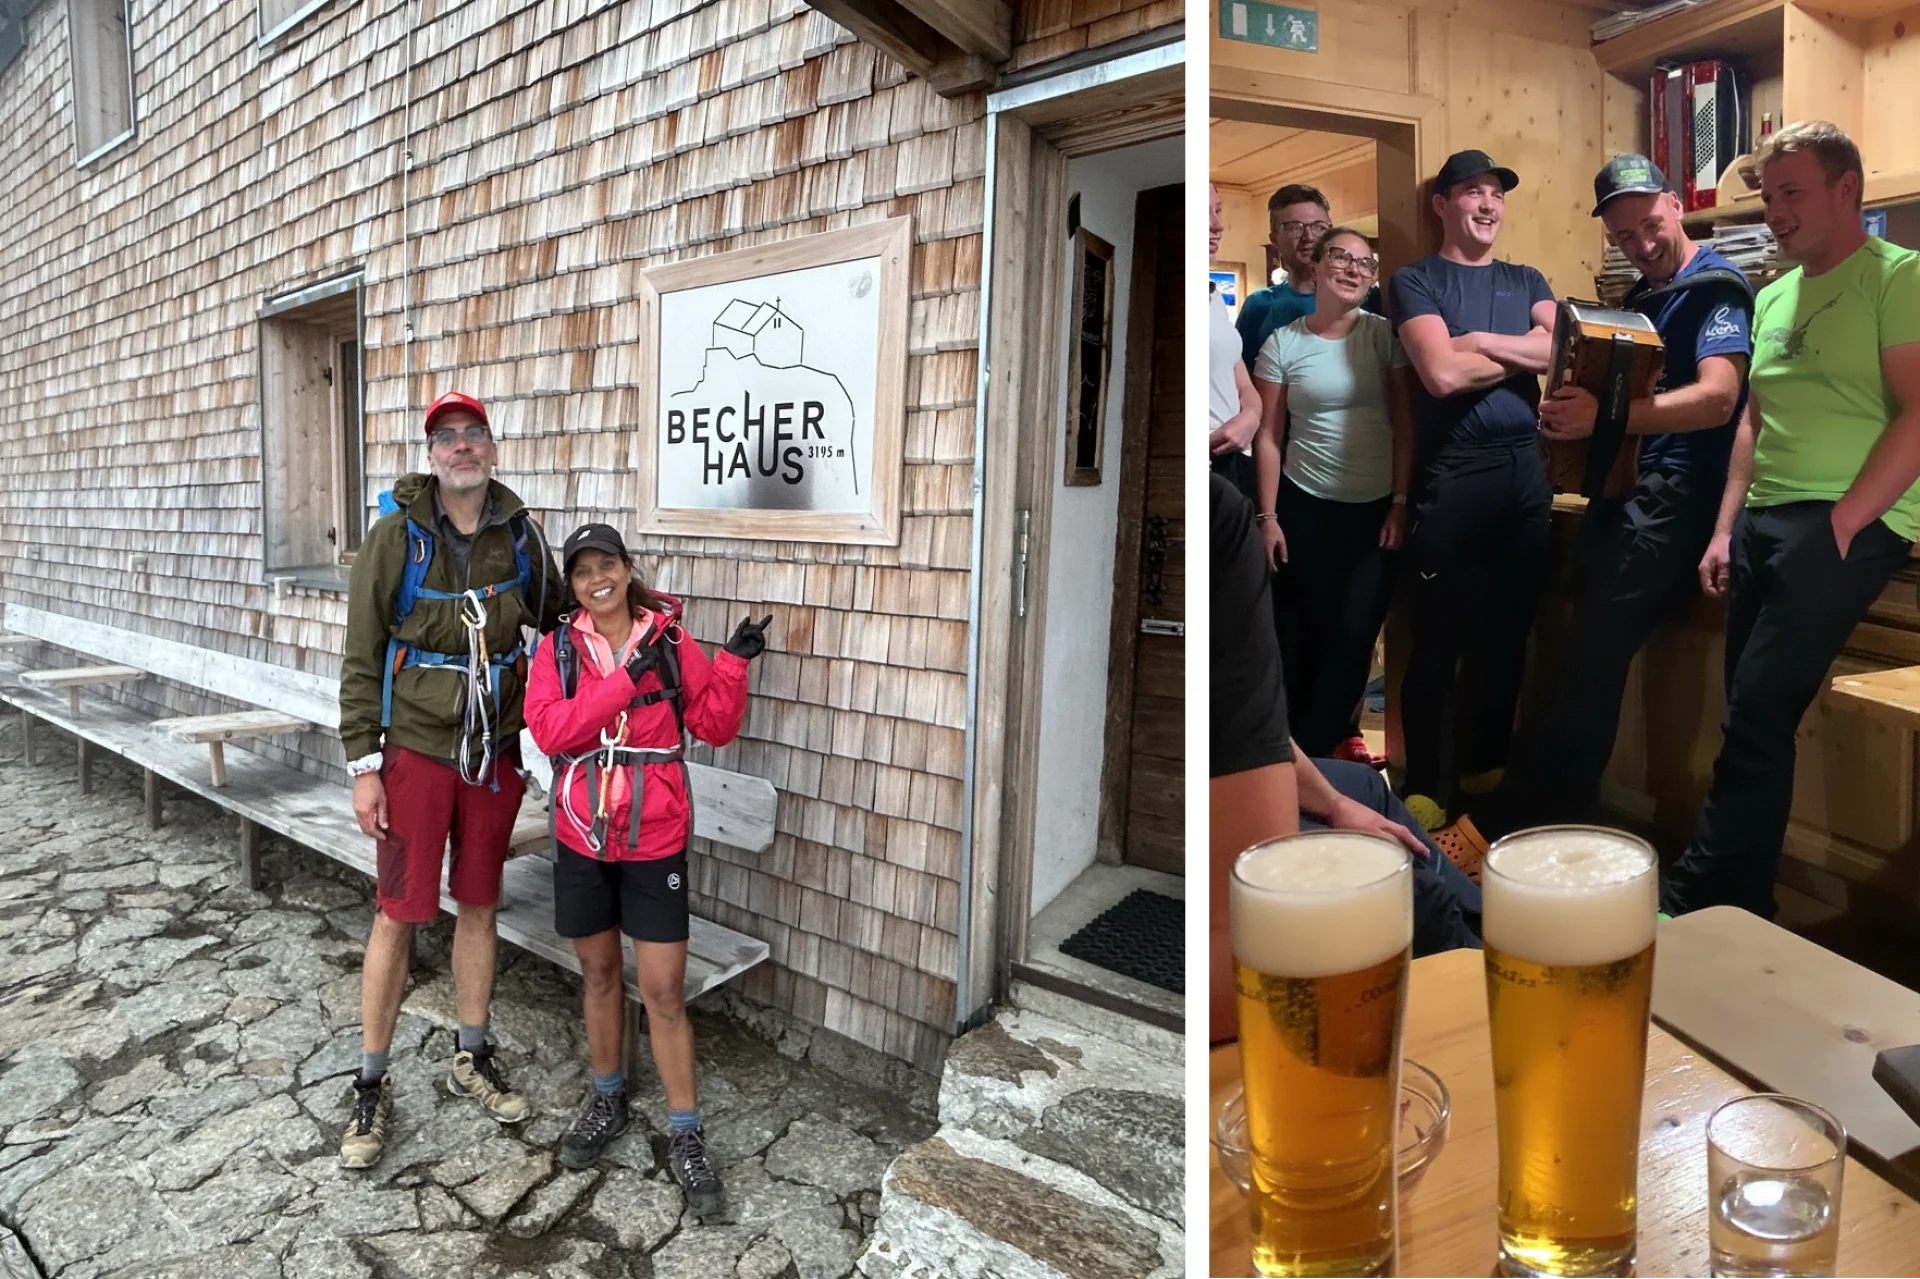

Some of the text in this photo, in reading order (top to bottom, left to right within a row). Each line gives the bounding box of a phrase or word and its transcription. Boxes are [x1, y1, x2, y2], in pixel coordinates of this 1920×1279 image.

[667, 390, 825, 444] BECHER
[703, 436, 804, 485] HAUS
[808, 445, 845, 459] 3195 m
